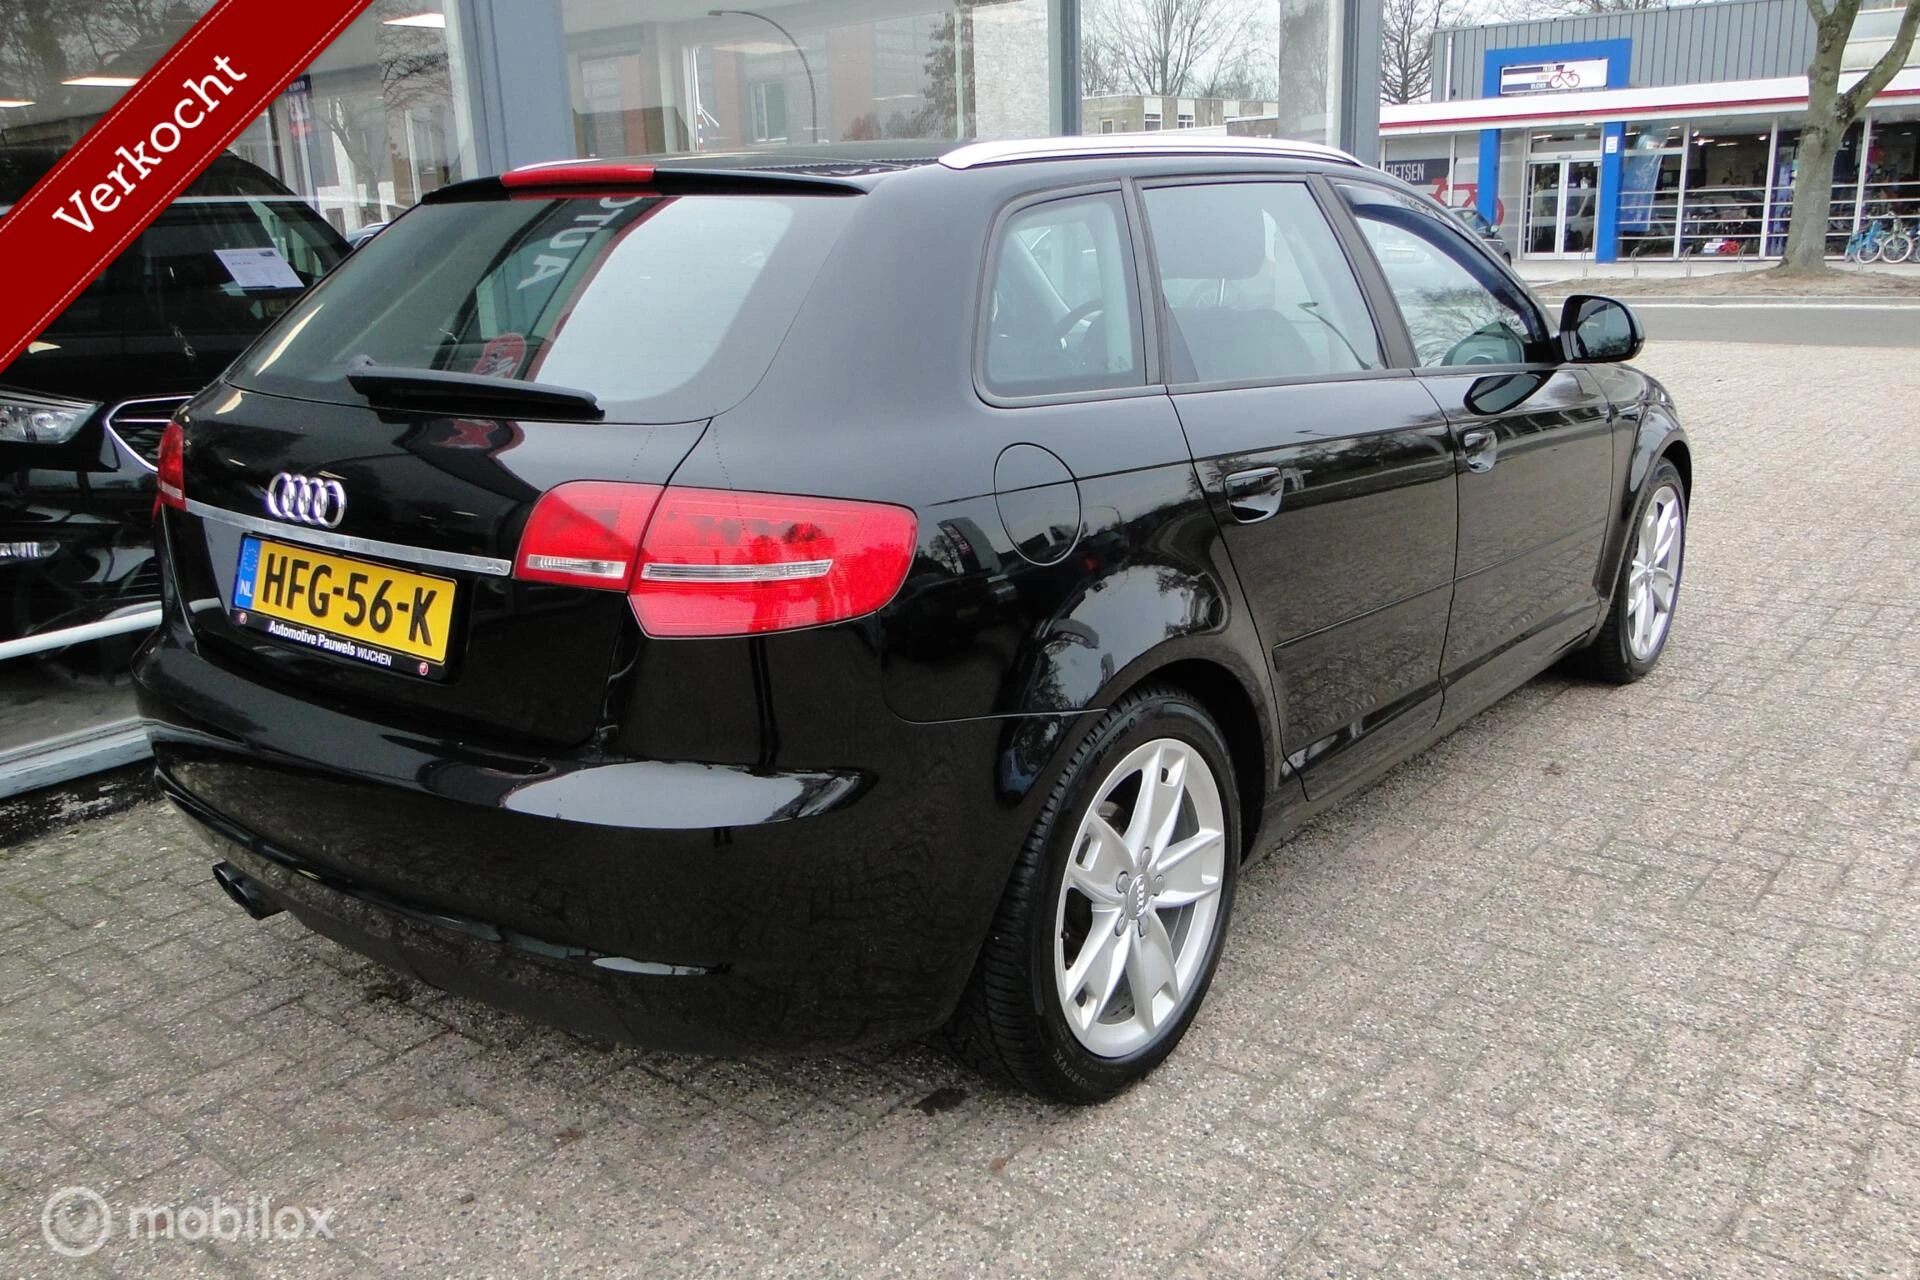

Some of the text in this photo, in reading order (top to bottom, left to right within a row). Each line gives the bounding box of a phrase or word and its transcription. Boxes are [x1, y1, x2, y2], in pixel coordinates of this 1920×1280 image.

[239, 582, 253, 598] NL
[262, 553, 438, 647] HFG-56-K
[268, 620, 317, 645] Automotive
[318, 633, 356, 656] Pauwels
